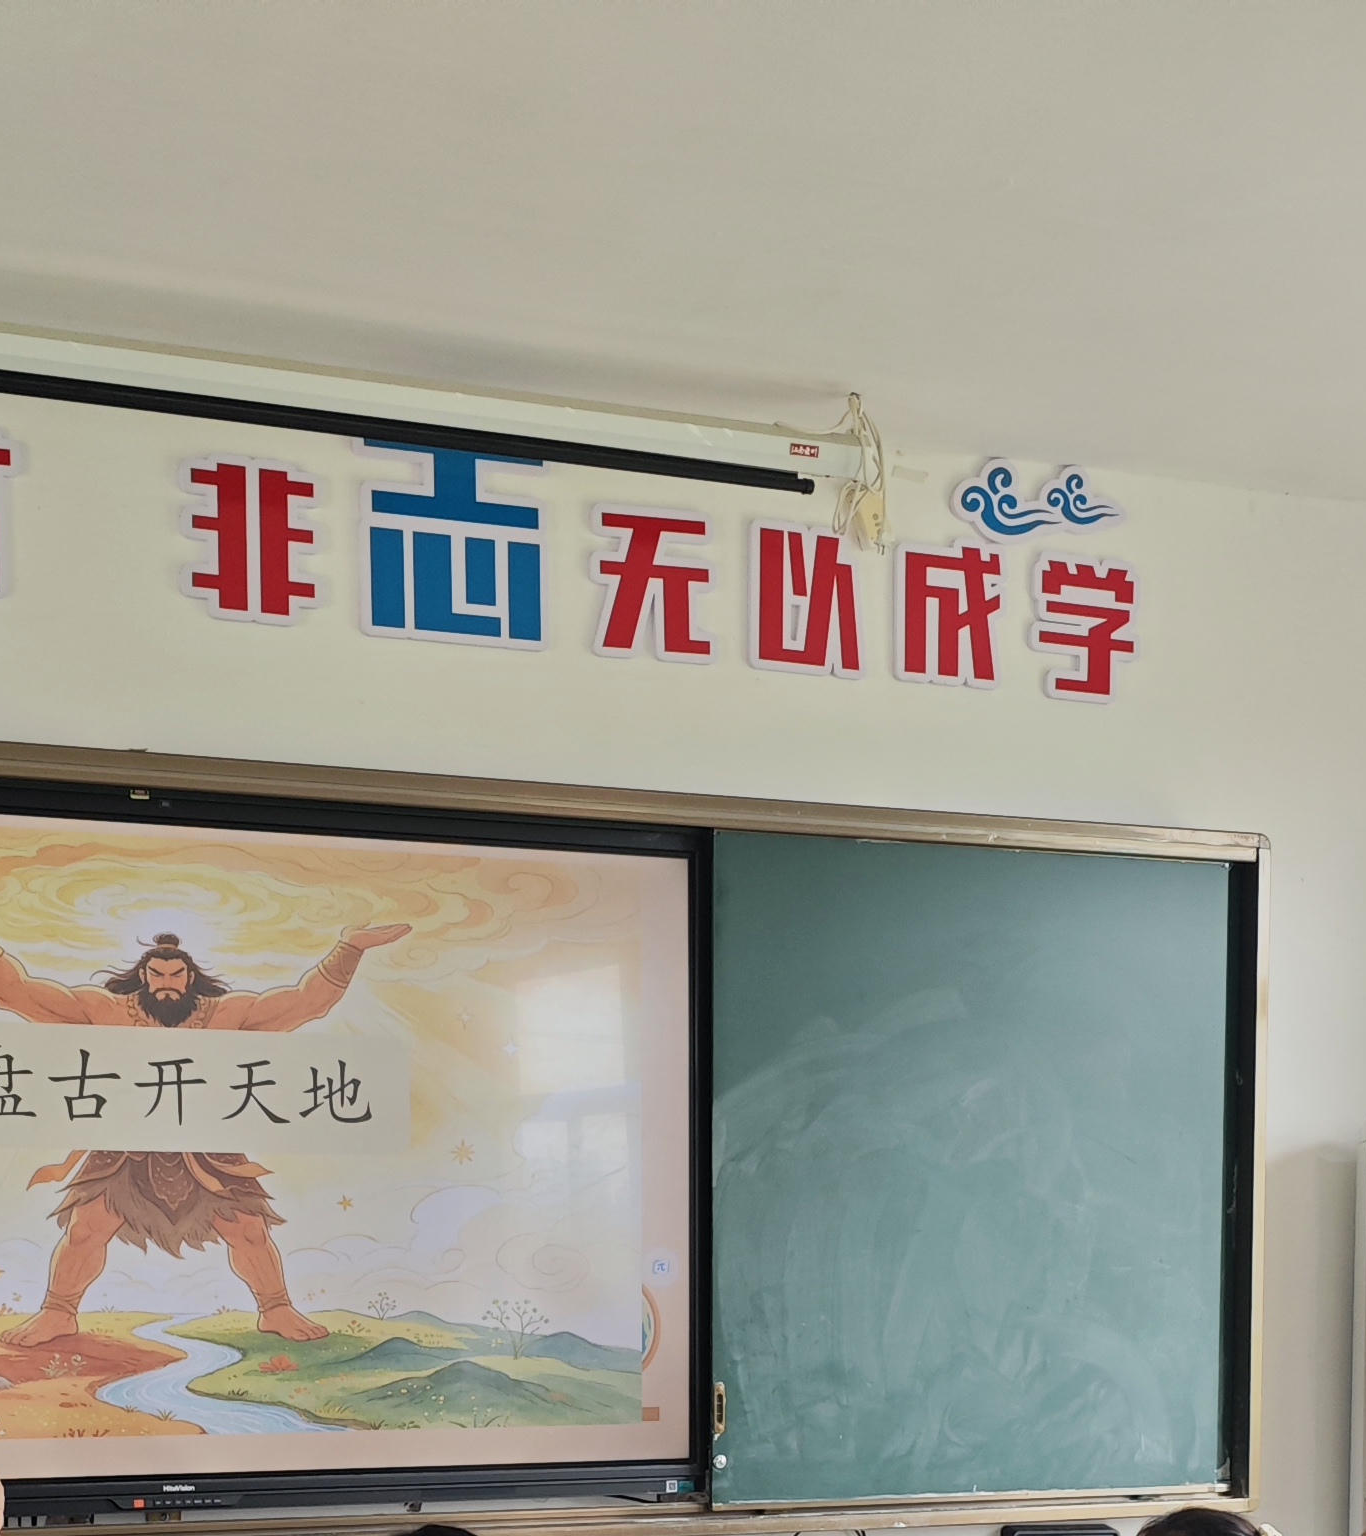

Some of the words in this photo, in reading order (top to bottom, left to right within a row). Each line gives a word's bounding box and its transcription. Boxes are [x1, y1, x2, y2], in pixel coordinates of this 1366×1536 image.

[190, 437, 1135, 696] 非志无以成学
